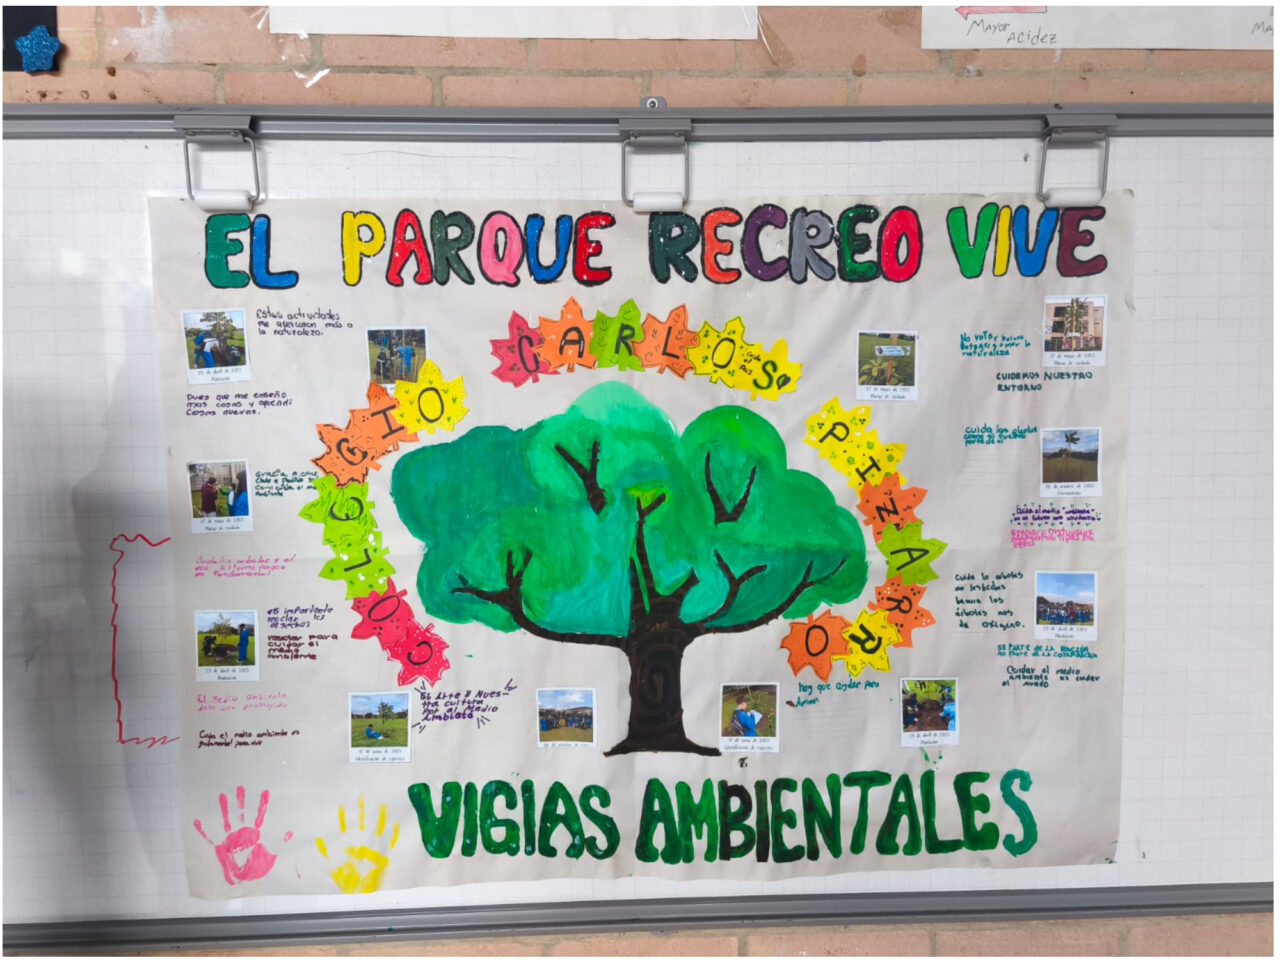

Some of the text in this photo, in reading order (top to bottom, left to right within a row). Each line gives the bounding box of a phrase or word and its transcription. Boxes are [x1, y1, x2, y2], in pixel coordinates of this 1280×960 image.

[203, 203, 1106, 290] EL PARQUE RECREO VIVE
[1044, 371, 1093, 381] NUESTRO
[407, 769, 1039, 864] VIGIAS AMBIENTALES
